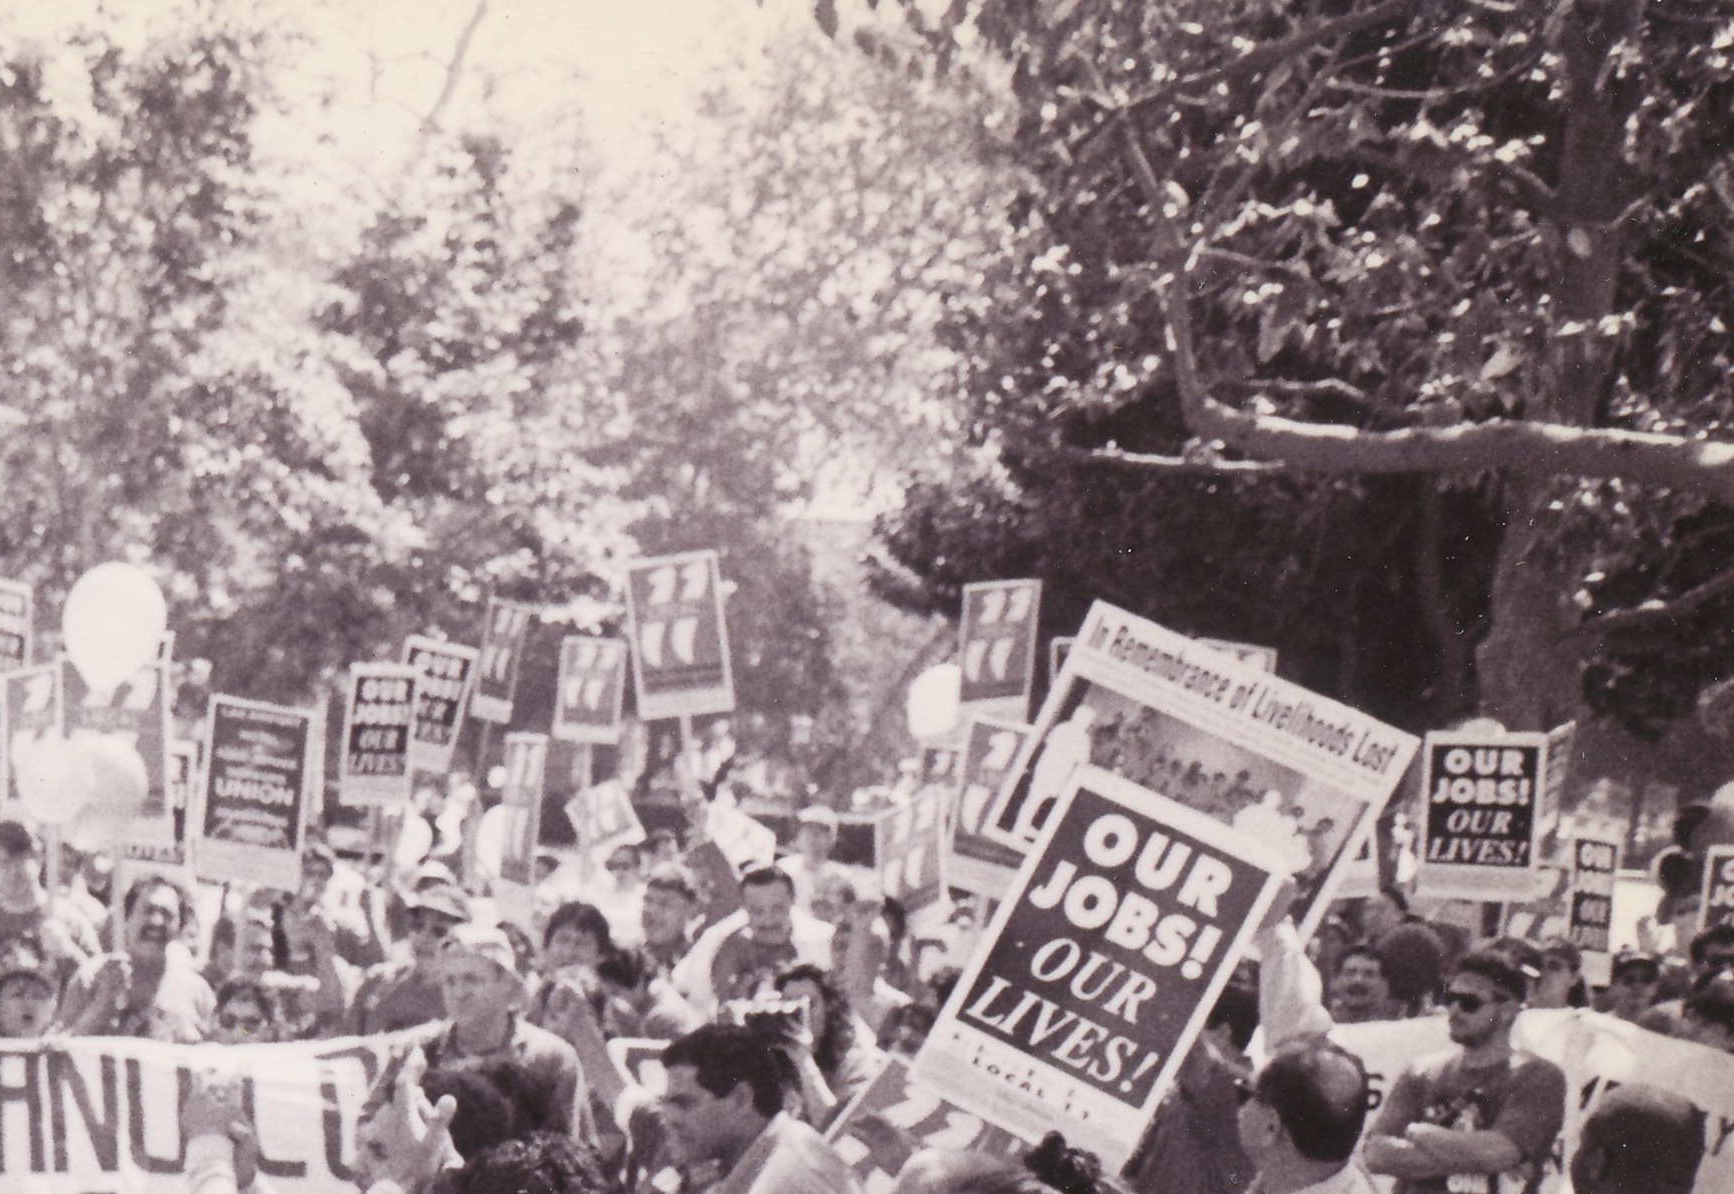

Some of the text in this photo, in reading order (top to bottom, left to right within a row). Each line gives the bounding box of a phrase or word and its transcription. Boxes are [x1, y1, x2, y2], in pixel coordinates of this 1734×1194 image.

[1109, 625, 1231, 703] Remembrance
[1230, 680, 1259, 713] of
[1251, 686, 1355, 756] Livelihoods
[1352, 731, 1398, 775] Lost
[1432, 777, 1532, 806] JOBS!
[1444, 748, 1525, 776] OUR
[1083, 813, 1233, 918] OUR
[1428, 836, 1530, 866] LIVES!
[1447, 808, 1513, 835] OUR
[1028, 860, 1223, 980] JOBS!
[1030, 937, 1158, 1025] OUR
[966, 975, 1160, 1094] LIVES!
